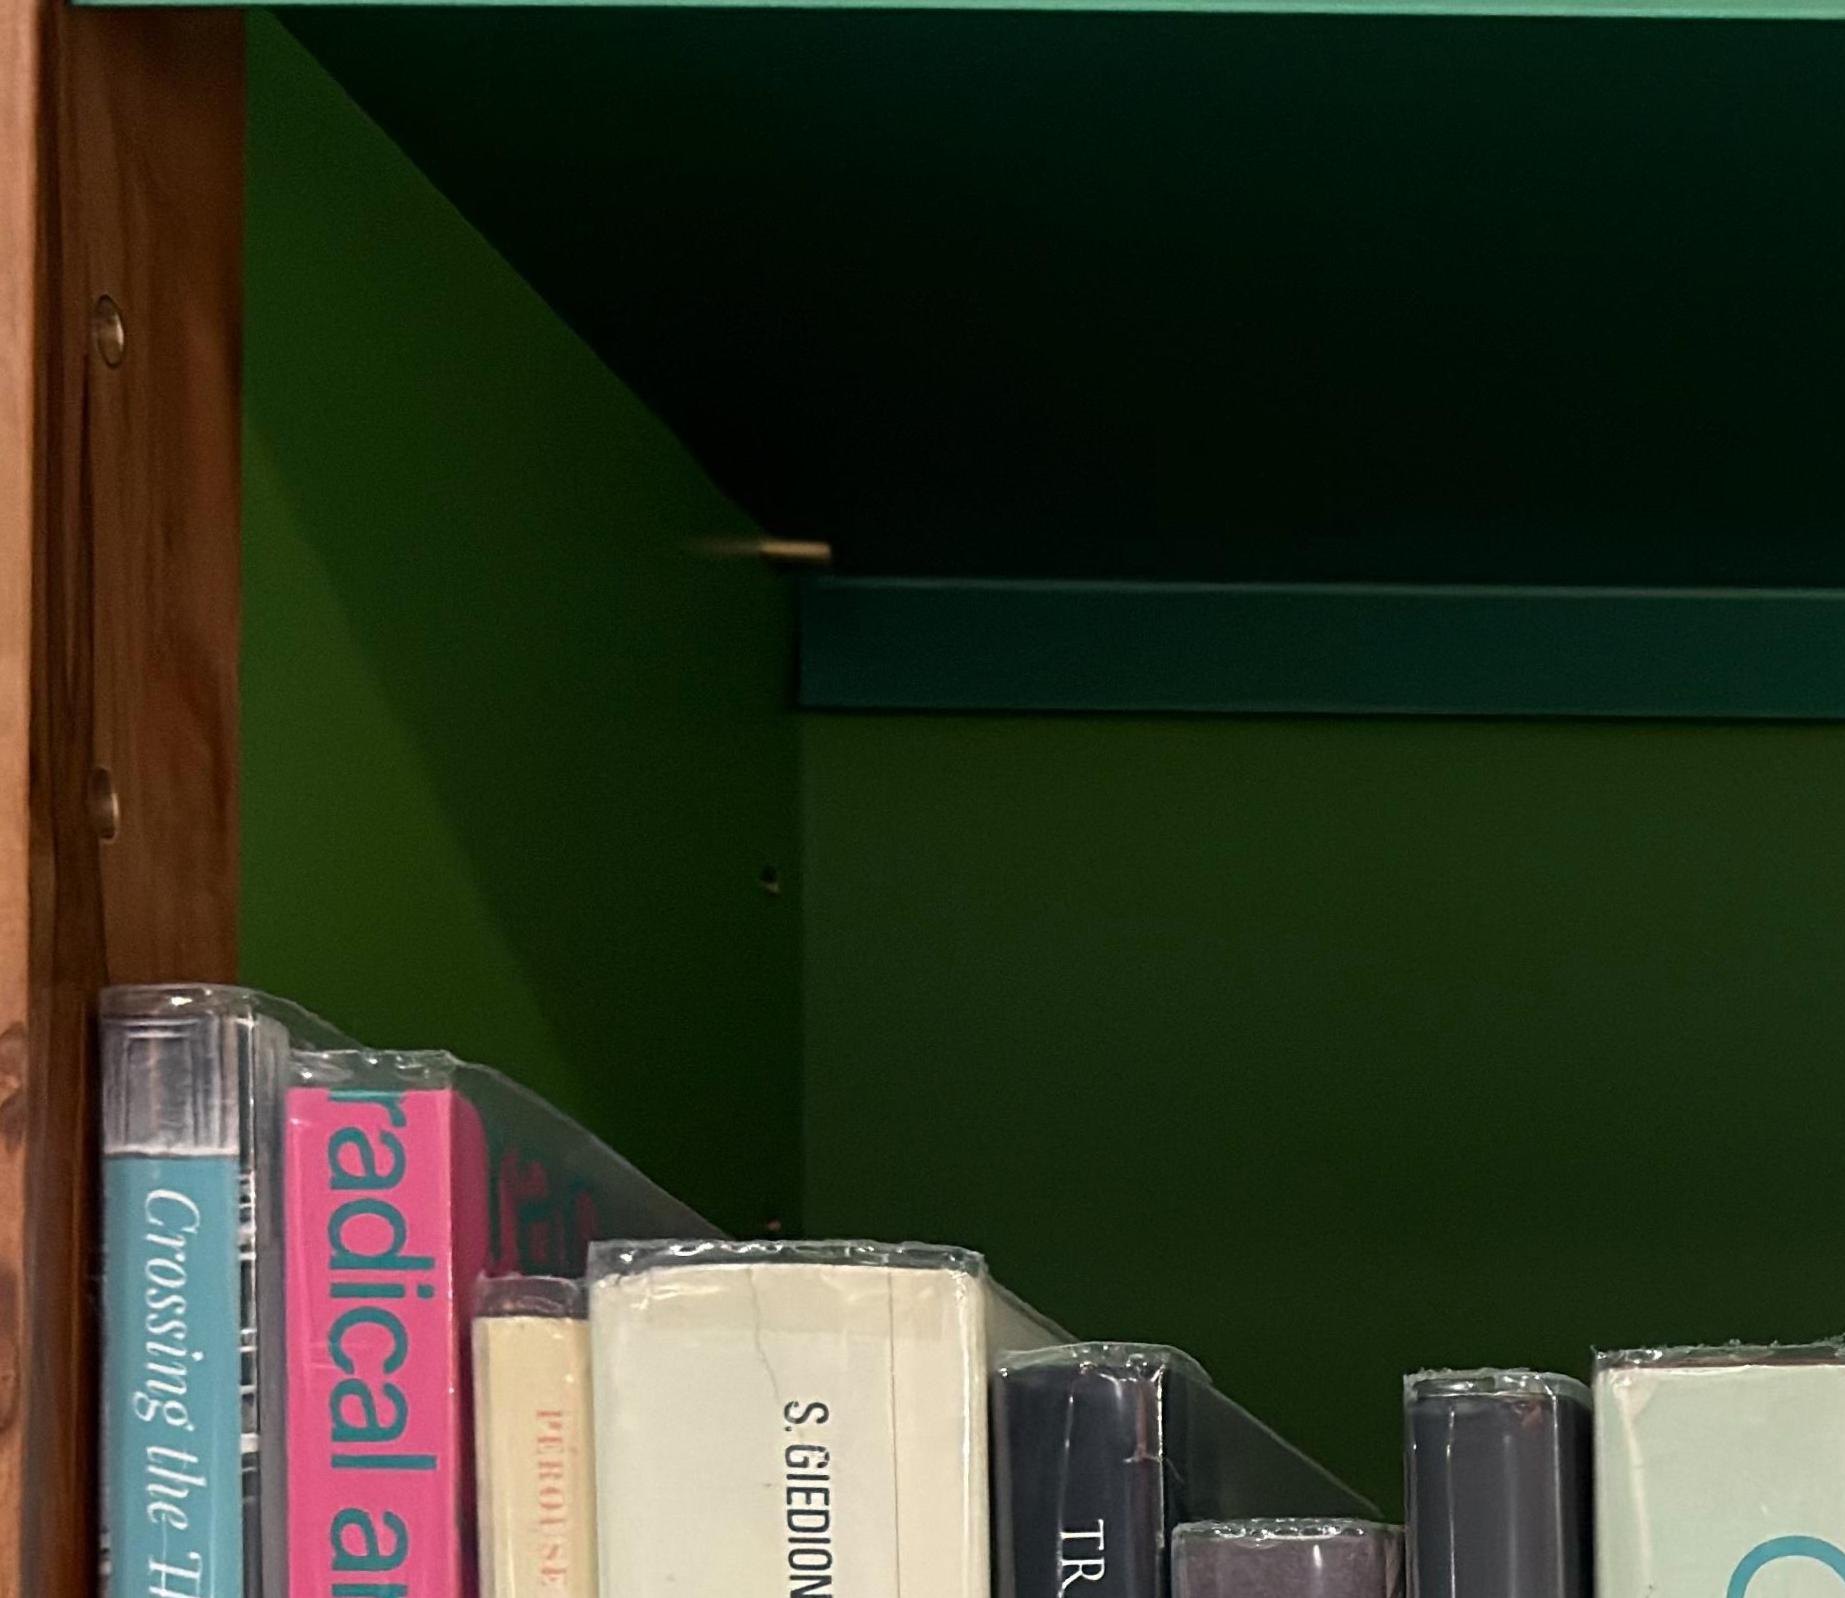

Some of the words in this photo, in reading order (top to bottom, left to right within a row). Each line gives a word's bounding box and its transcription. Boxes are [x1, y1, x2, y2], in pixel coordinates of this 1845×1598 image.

[132, 1188, 205, 1432] Crossing
[328, 1090, 437, 1471] radical
[146, 1446, 207, 1530] the
[783, 1400, 830, 1432] S.
